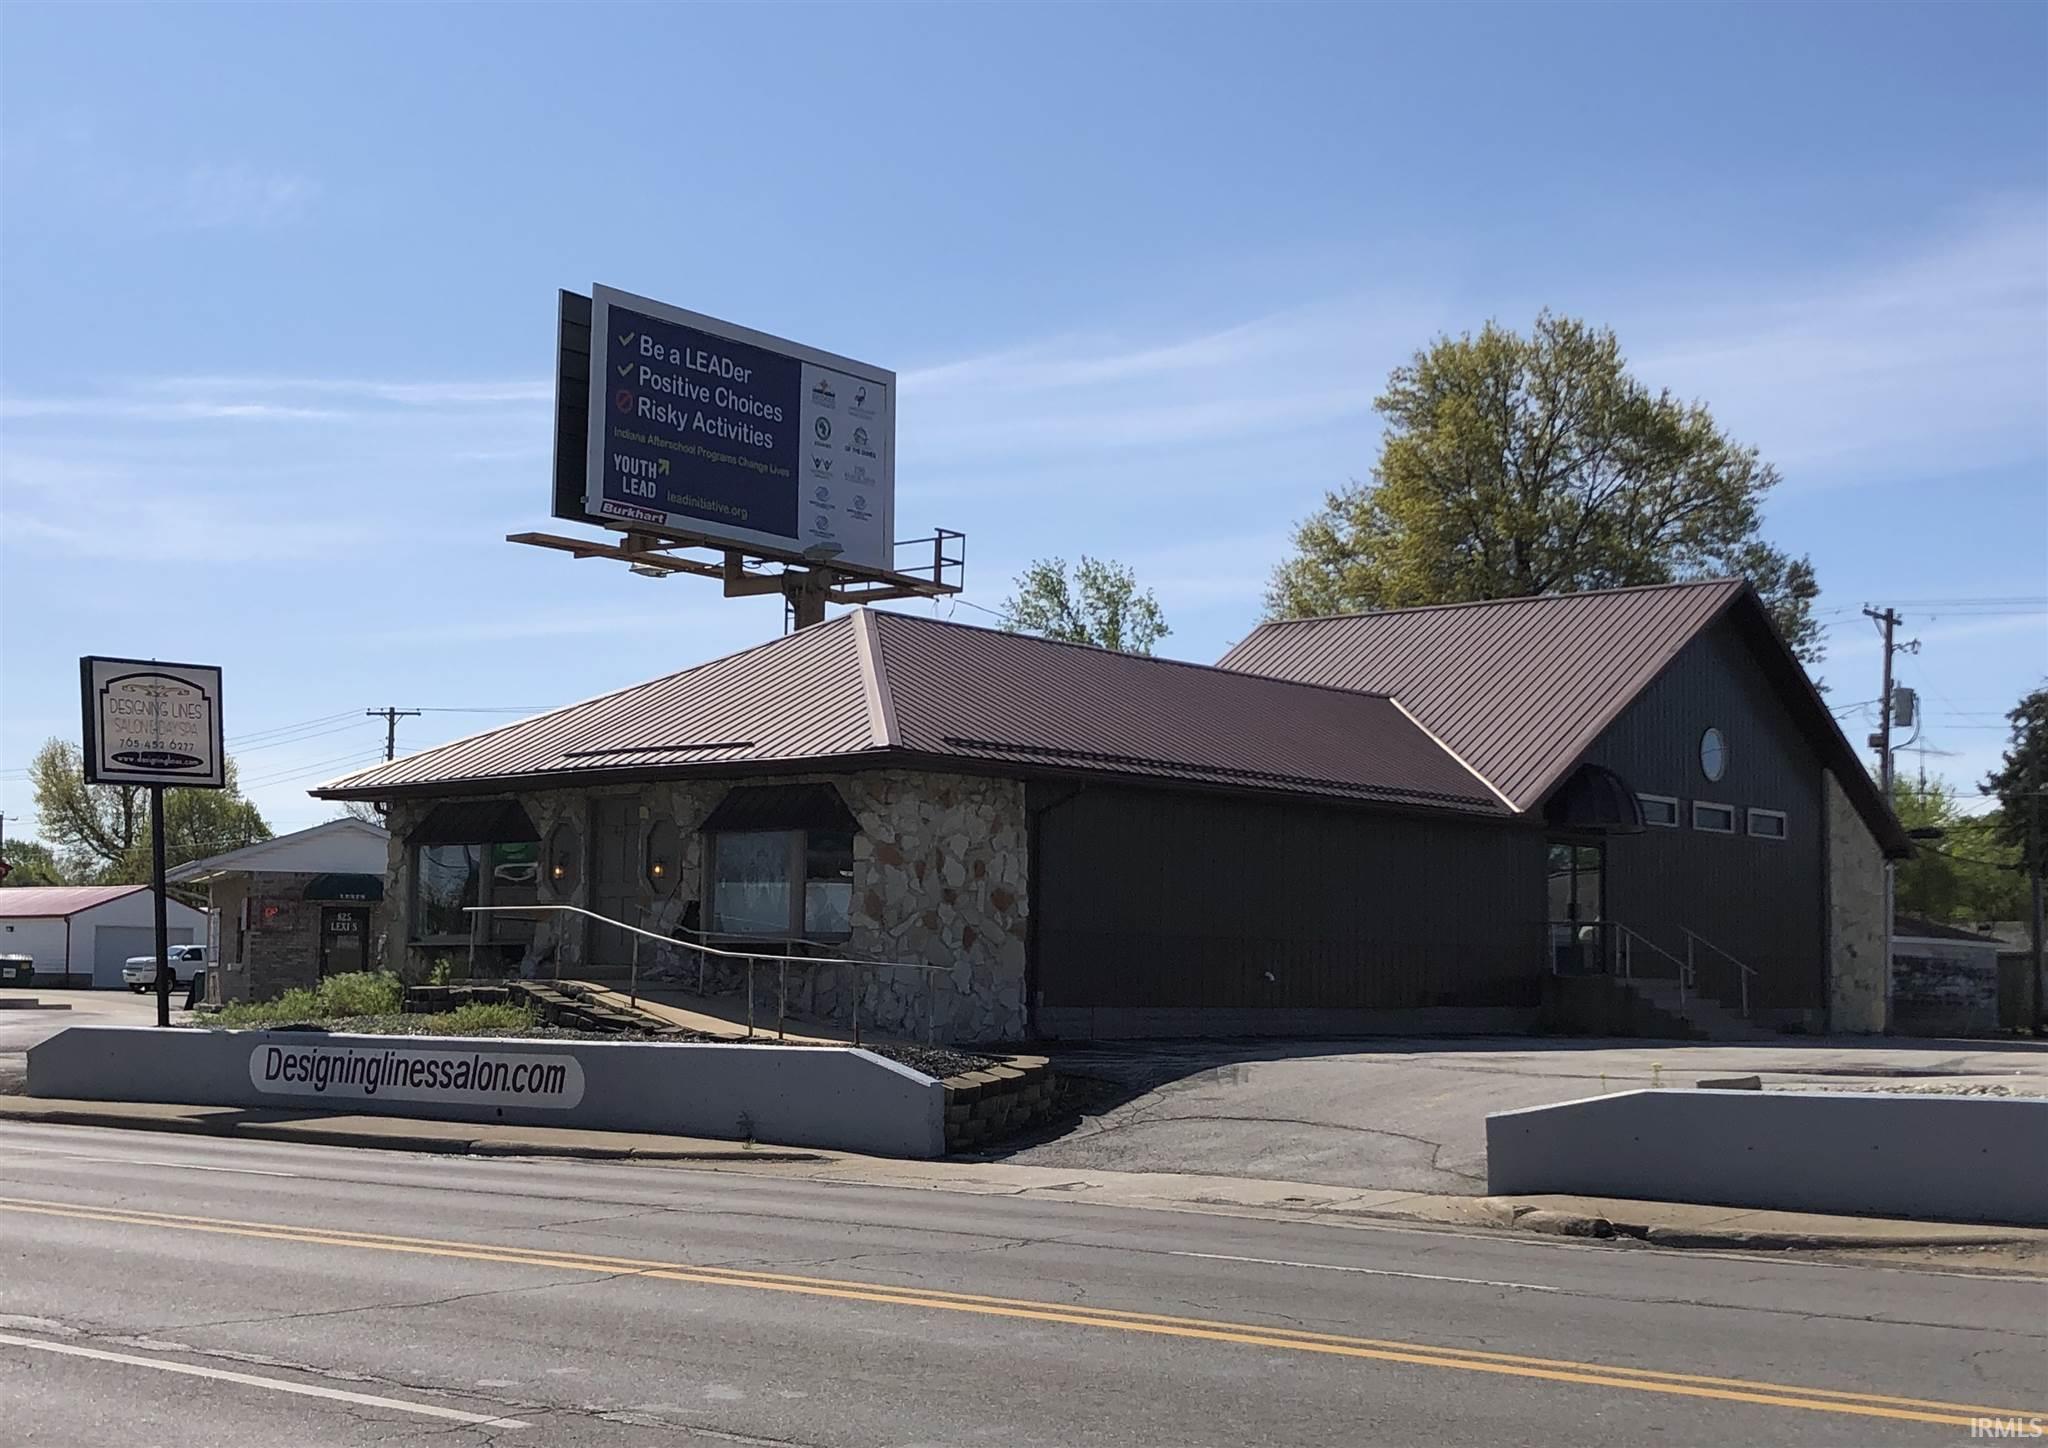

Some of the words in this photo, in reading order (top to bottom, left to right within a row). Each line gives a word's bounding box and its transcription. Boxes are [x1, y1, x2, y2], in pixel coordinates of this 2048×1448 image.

[640, 335, 665, 360] Be
[669, 349, 681, 366] a
[686, 347, 752, 384] LEADer
[639, 366, 710, 403] Positive
[715, 387, 783, 423] Choices
[638, 396, 688, 431] Risky
[692, 411, 774, 449] Activities
[613, 453, 658, 479] YOUTH
[614, 426, 646, 444] Indiana
[647, 434, 696, 456] Afterschool
[697, 446, 737, 466] Programs
[738, 456, 769, 475] Change
[770, 462, 790, 478] Lives
[622, 475, 657, 499] LEAD
[602, 502, 664, 525] Burkhart
[667, 490, 749, 520] leadinitiative.org
[109, 698, 169, 717] DESIGNING
[171, 703, 202, 720] LINES
[120, 737, 140, 748] 765
[144, 740, 165, 750] 452
[169, 738, 194, 752] 6277
[264, 1047, 567, 1096] Designinglinessalon.com
